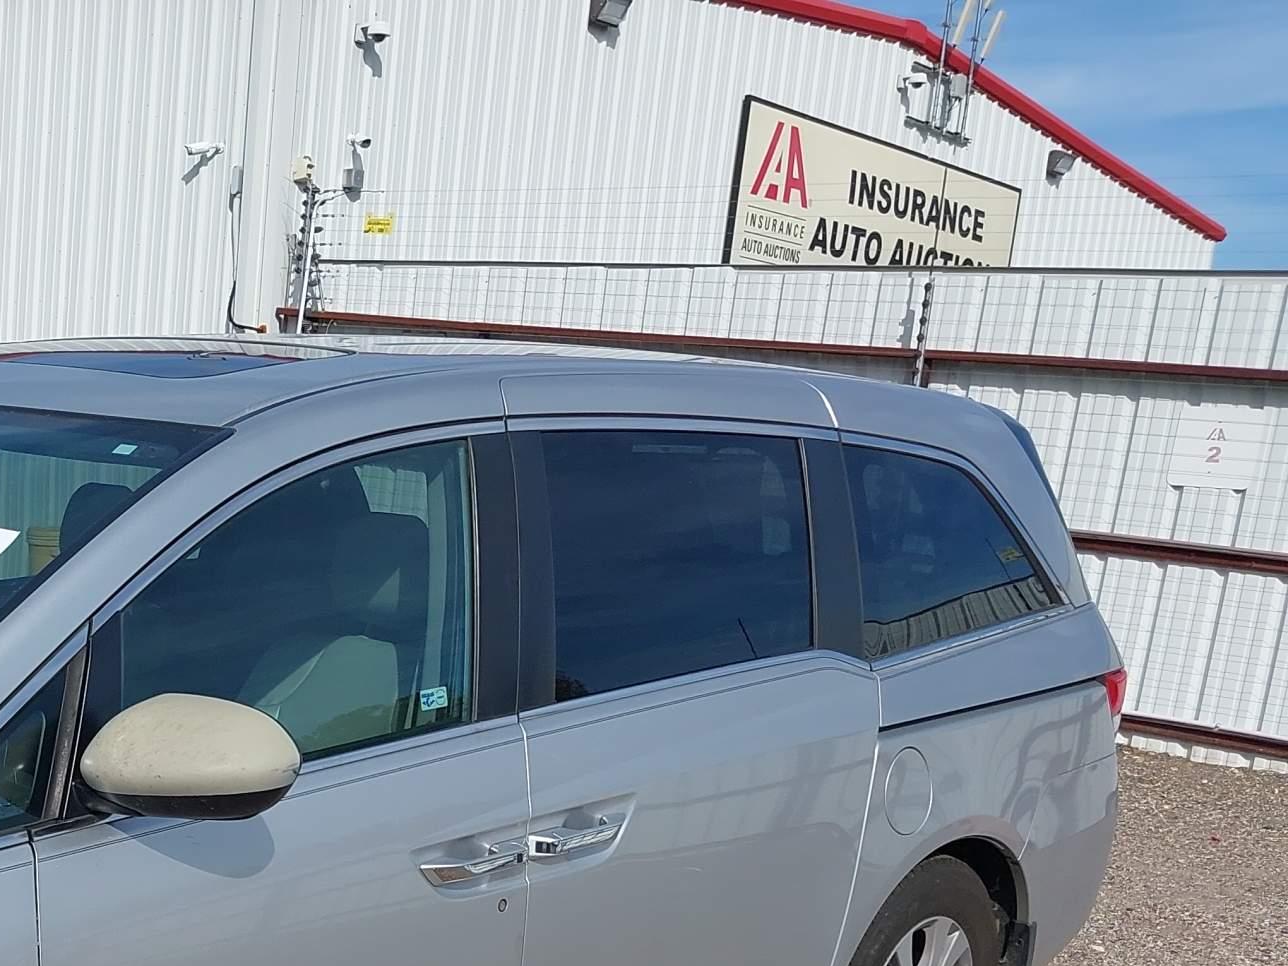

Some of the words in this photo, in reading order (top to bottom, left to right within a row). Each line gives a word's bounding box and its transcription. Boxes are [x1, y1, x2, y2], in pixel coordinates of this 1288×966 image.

[848, 169, 985, 242] INSURANCE
[744, 212, 806, 239] INSURANCE
[741, 237, 762, 257] AUTO
[762, 242, 801, 264] AUCTIONS
[809, 217, 883, 266] AUTO
[1205, 446, 1222, 463] 2
